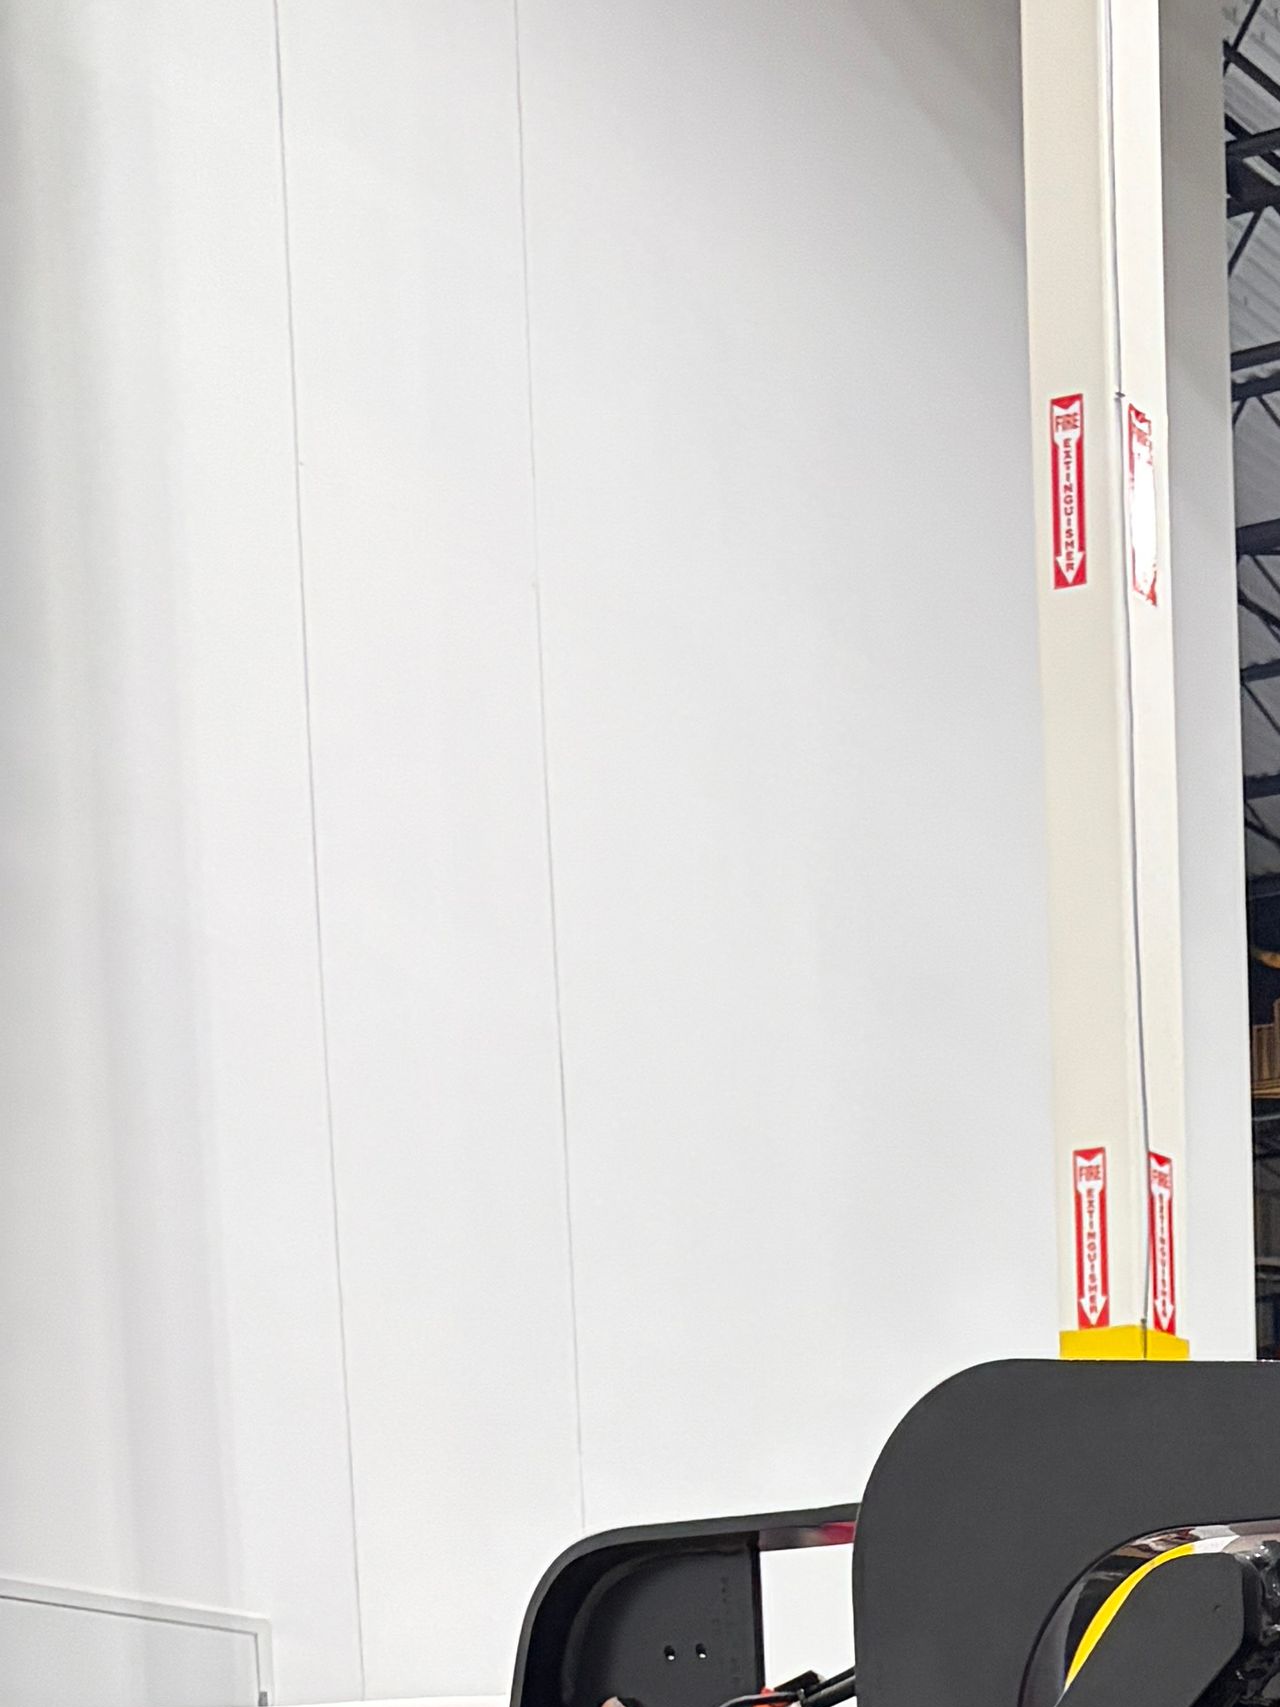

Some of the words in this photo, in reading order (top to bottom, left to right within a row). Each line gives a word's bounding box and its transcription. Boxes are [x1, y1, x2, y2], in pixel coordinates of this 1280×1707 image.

[1056, 412, 1080, 432] FIRE
[1063, 438, 1074, 572] EXTINGUISHER
[1079, 1165, 1101, 1182] FIRE
[1086, 1188, 1098, 1314] EXTINGUISHER
